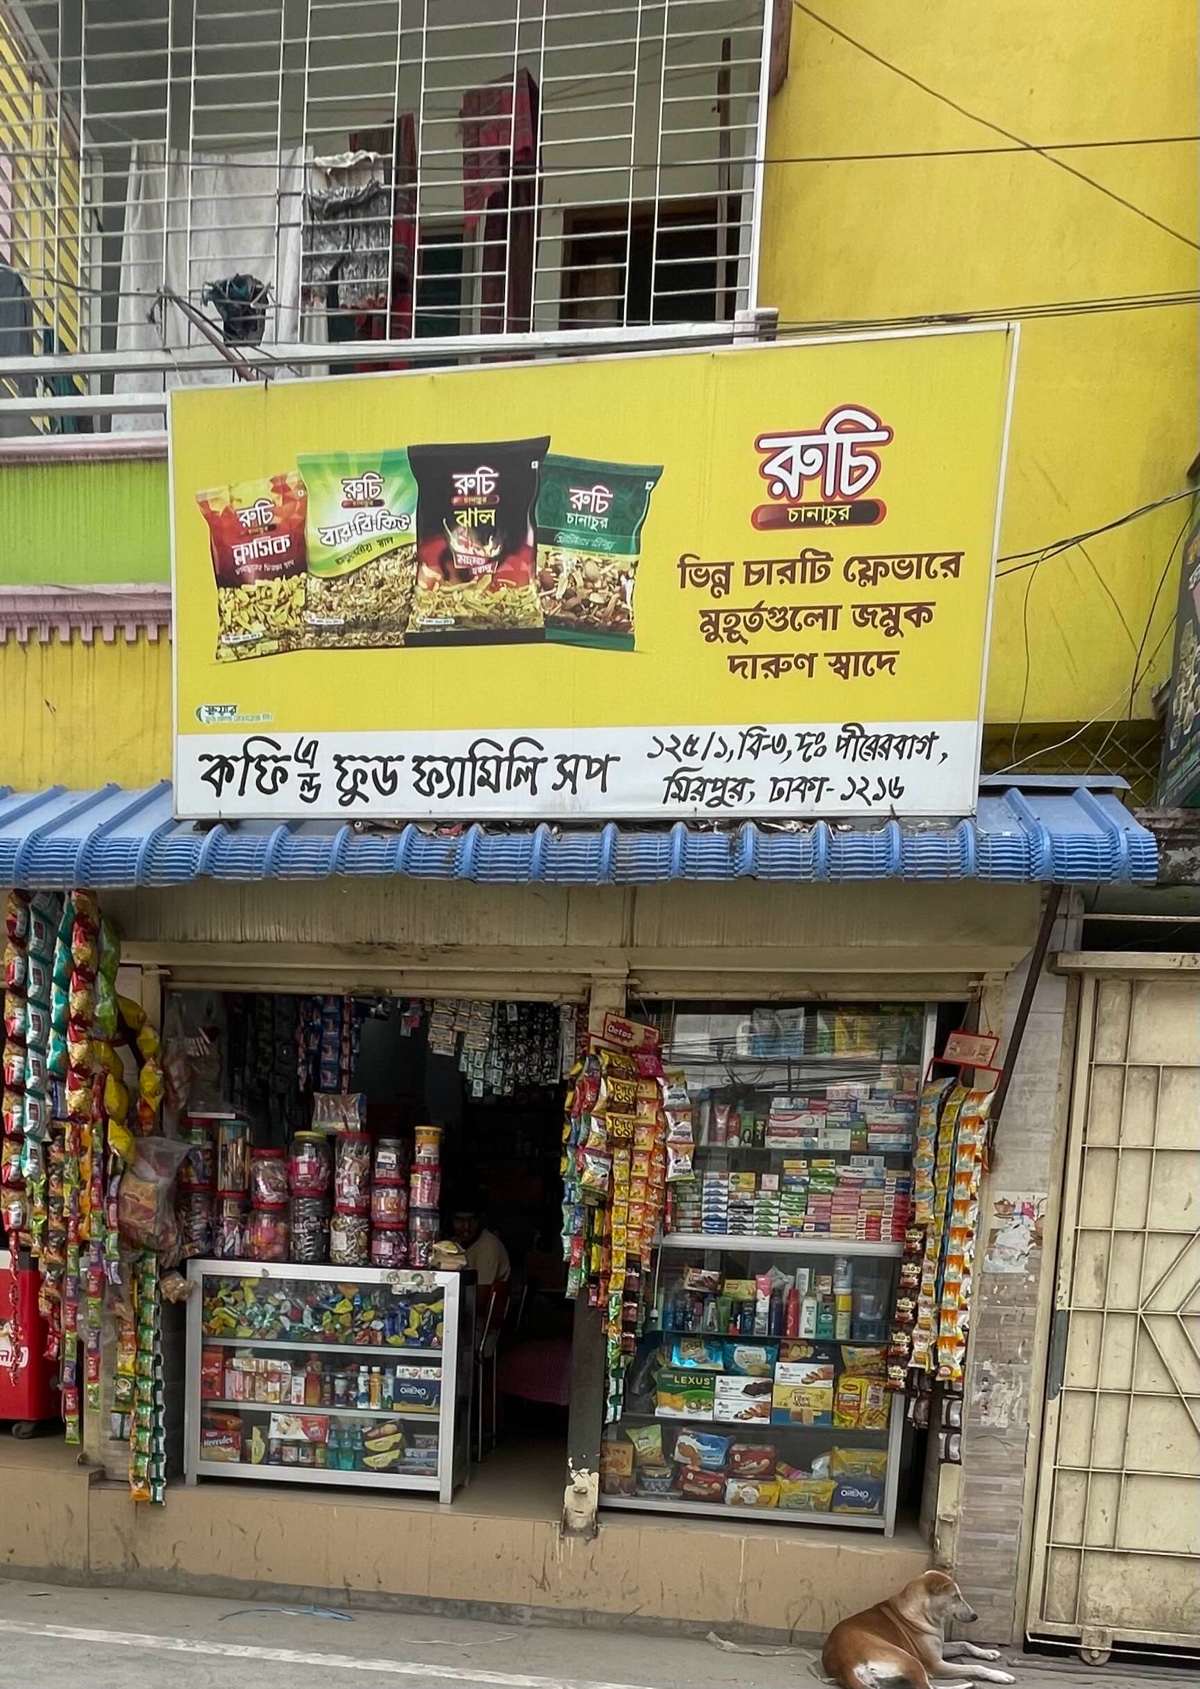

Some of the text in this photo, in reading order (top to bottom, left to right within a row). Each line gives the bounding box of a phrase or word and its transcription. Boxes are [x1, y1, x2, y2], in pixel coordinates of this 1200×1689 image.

[756, 405, 892, 502] রুচি
[342, 472, 384, 500] রুচি
[452, 466, 499, 496] রুচি
[236, 499, 275, 528] রুচি
[569, 485, 613, 513] রুচি
[453, 507, 496, 528] ঝাল
[566, 512, 609, 532] চানাচুর
[788, 504, 852, 526] চানাচুর
[231, 534, 291, 566] ক্লাসিক
[677, 548, 965, 599] ভিন্ন চারটি ফ্লেভারে
[699, 600, 936, 644] মুহূর্তগুলো জমুক
[727, 651, 900, 680] দারুণ স্বাদে
[199, 735, 291, 797] কফি
[333, 753, 405, 807] ফুড
[412, 736, 548, 799] ফ্যামিলি
[551, 753, 621, 795] সপ
[674, 1376, 711, 1386] LEXUS
